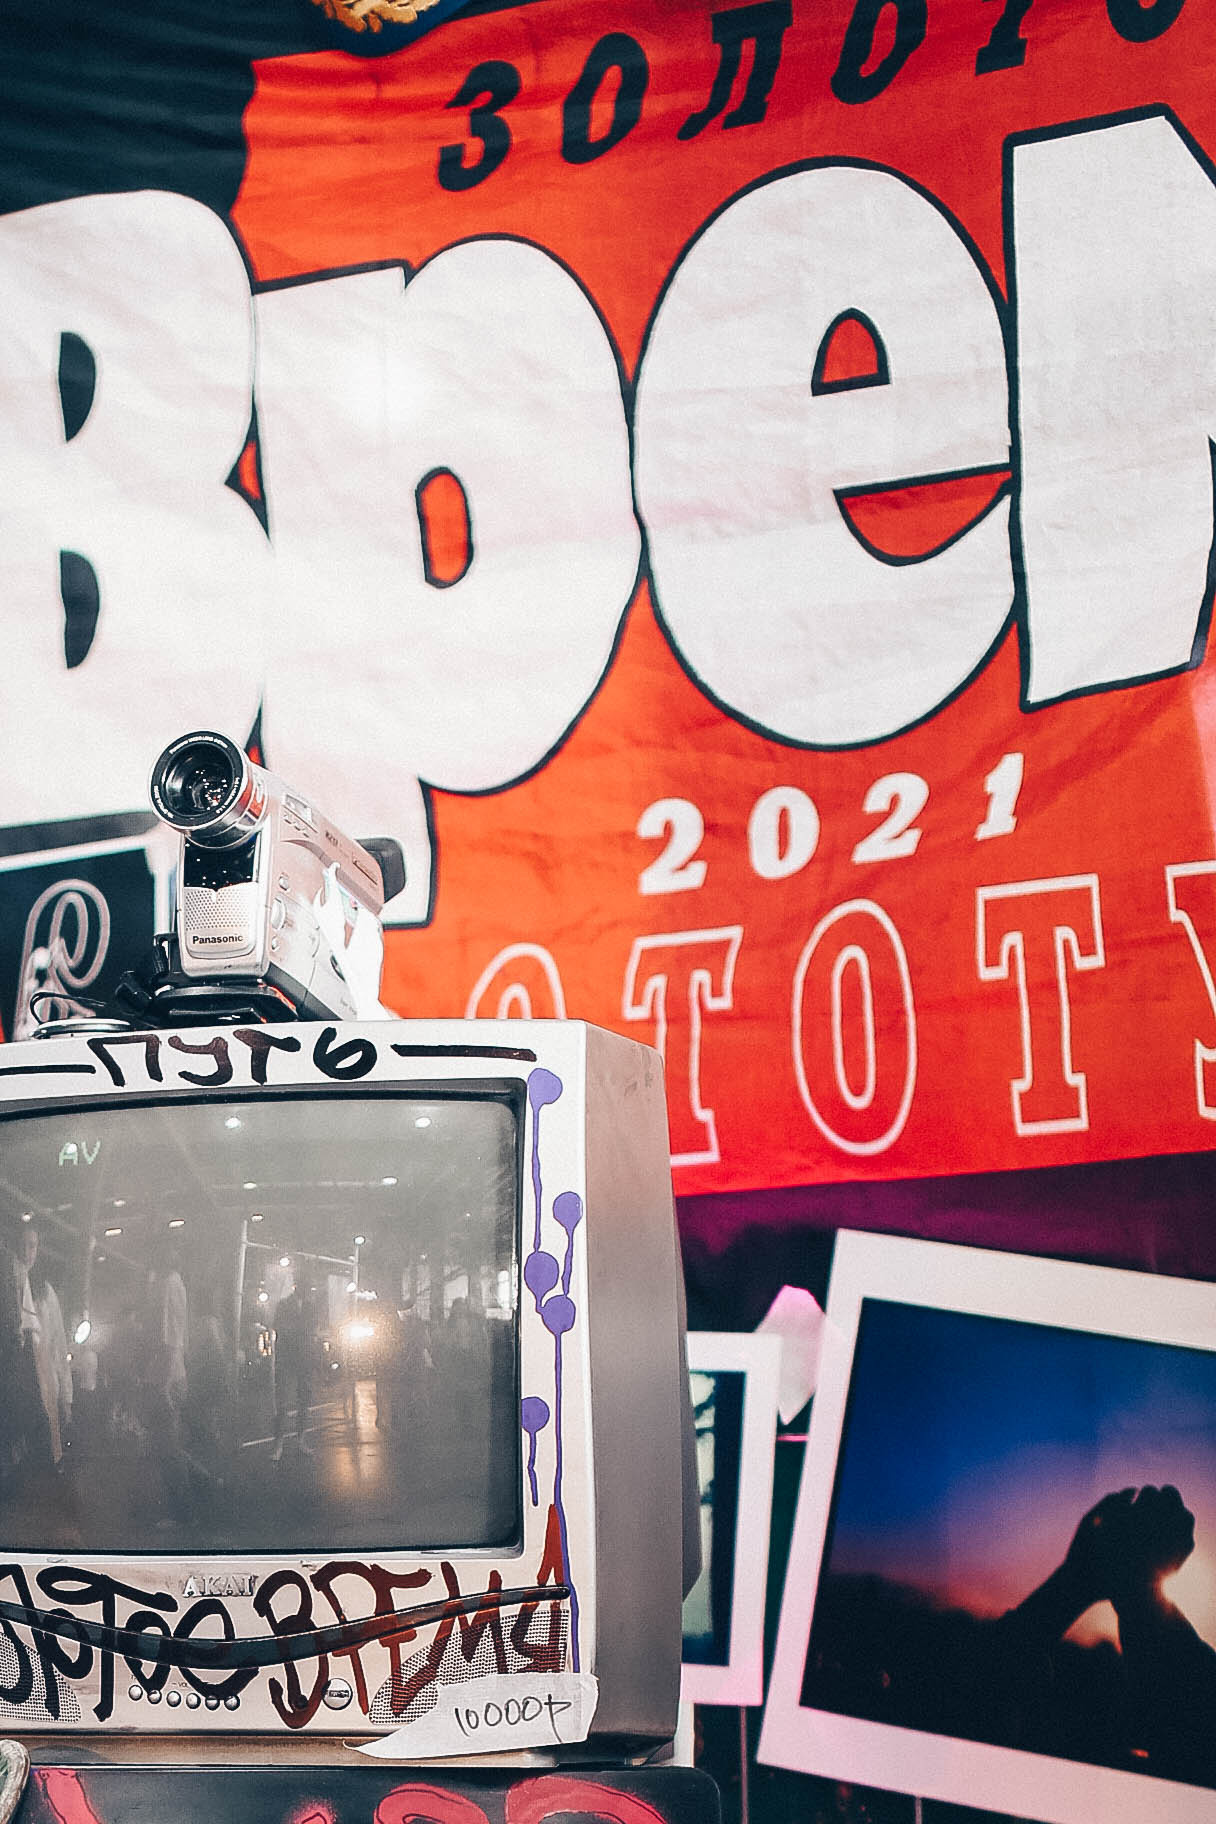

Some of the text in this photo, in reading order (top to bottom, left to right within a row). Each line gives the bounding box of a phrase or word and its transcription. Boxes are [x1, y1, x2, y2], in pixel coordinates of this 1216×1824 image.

[637, 752, 1025, 896] 2021
[192, 935, 244, 944] Panasonic
[58, 1141, 101, 1166] AV
[182, 1574, 258, 1598] AKAI
